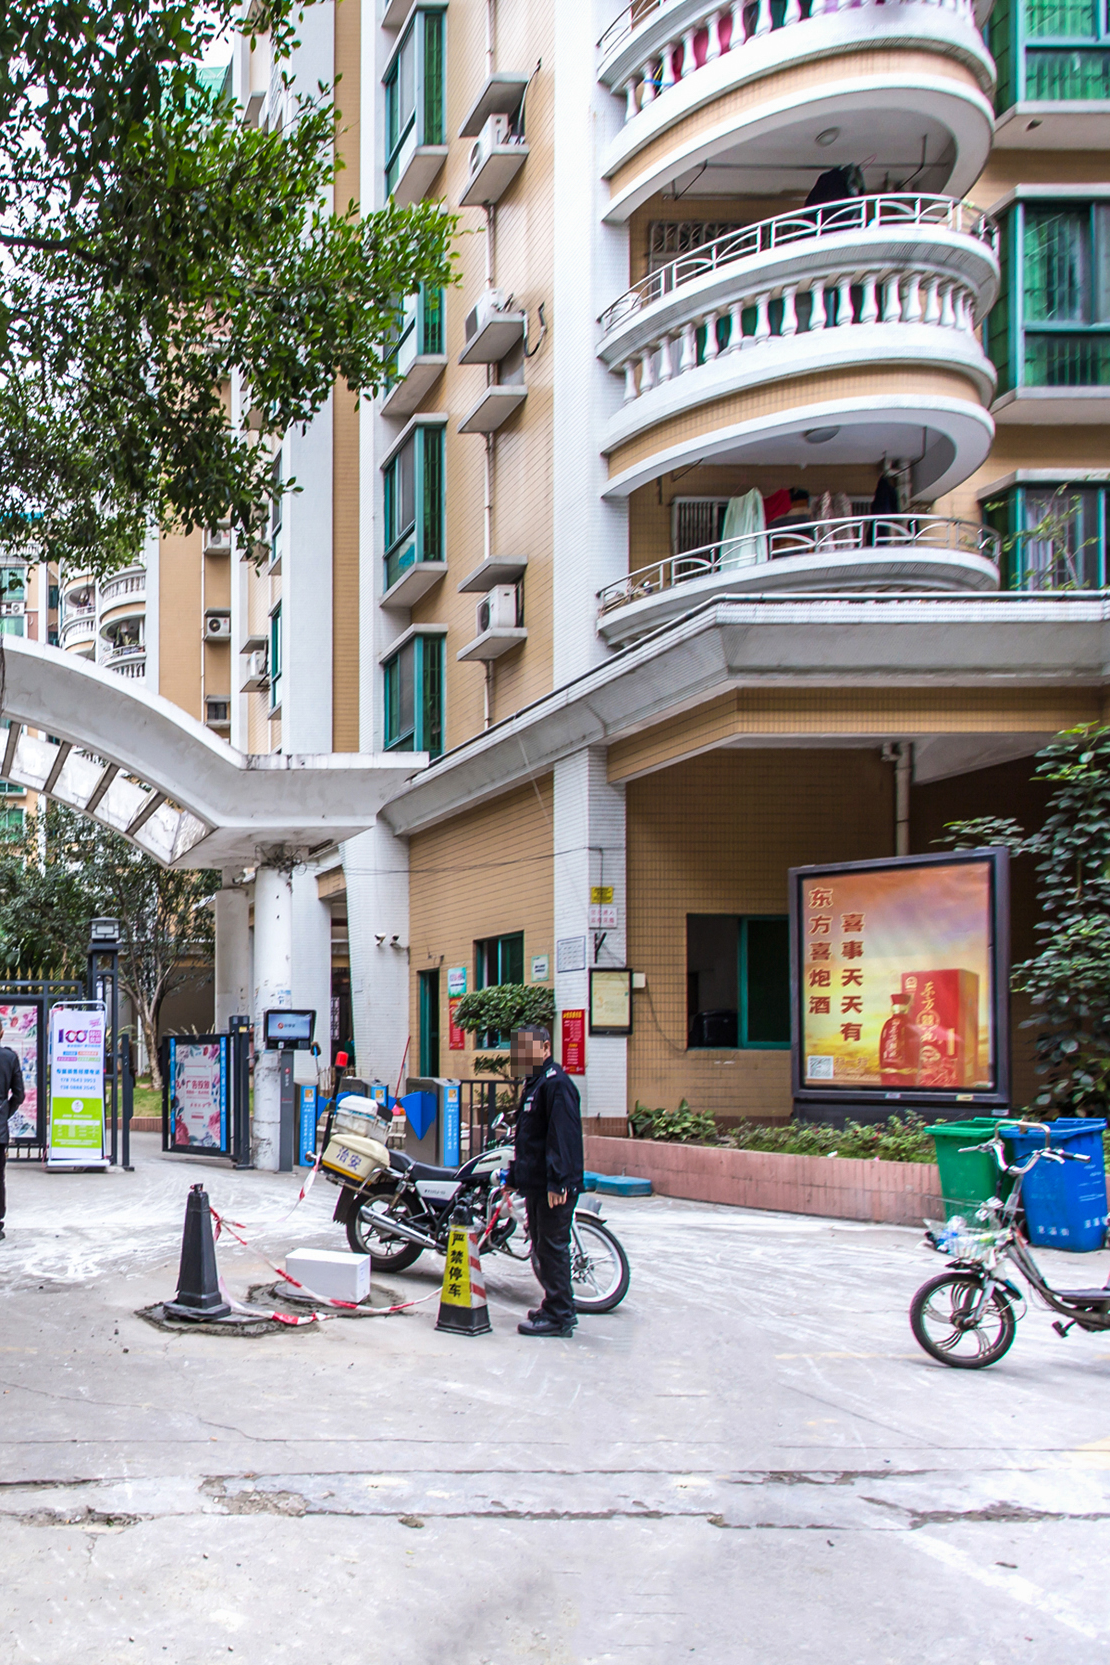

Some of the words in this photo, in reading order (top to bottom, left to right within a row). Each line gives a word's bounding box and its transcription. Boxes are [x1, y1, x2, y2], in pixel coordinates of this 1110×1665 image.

[809, 887, 833, 1014] 东方喜炮酒
[841, 912, 865, 1041] 喜事天天有
[335, 1146, 362, 1170] 治安
[448, 1233, 465, 1298] 严禁停车
